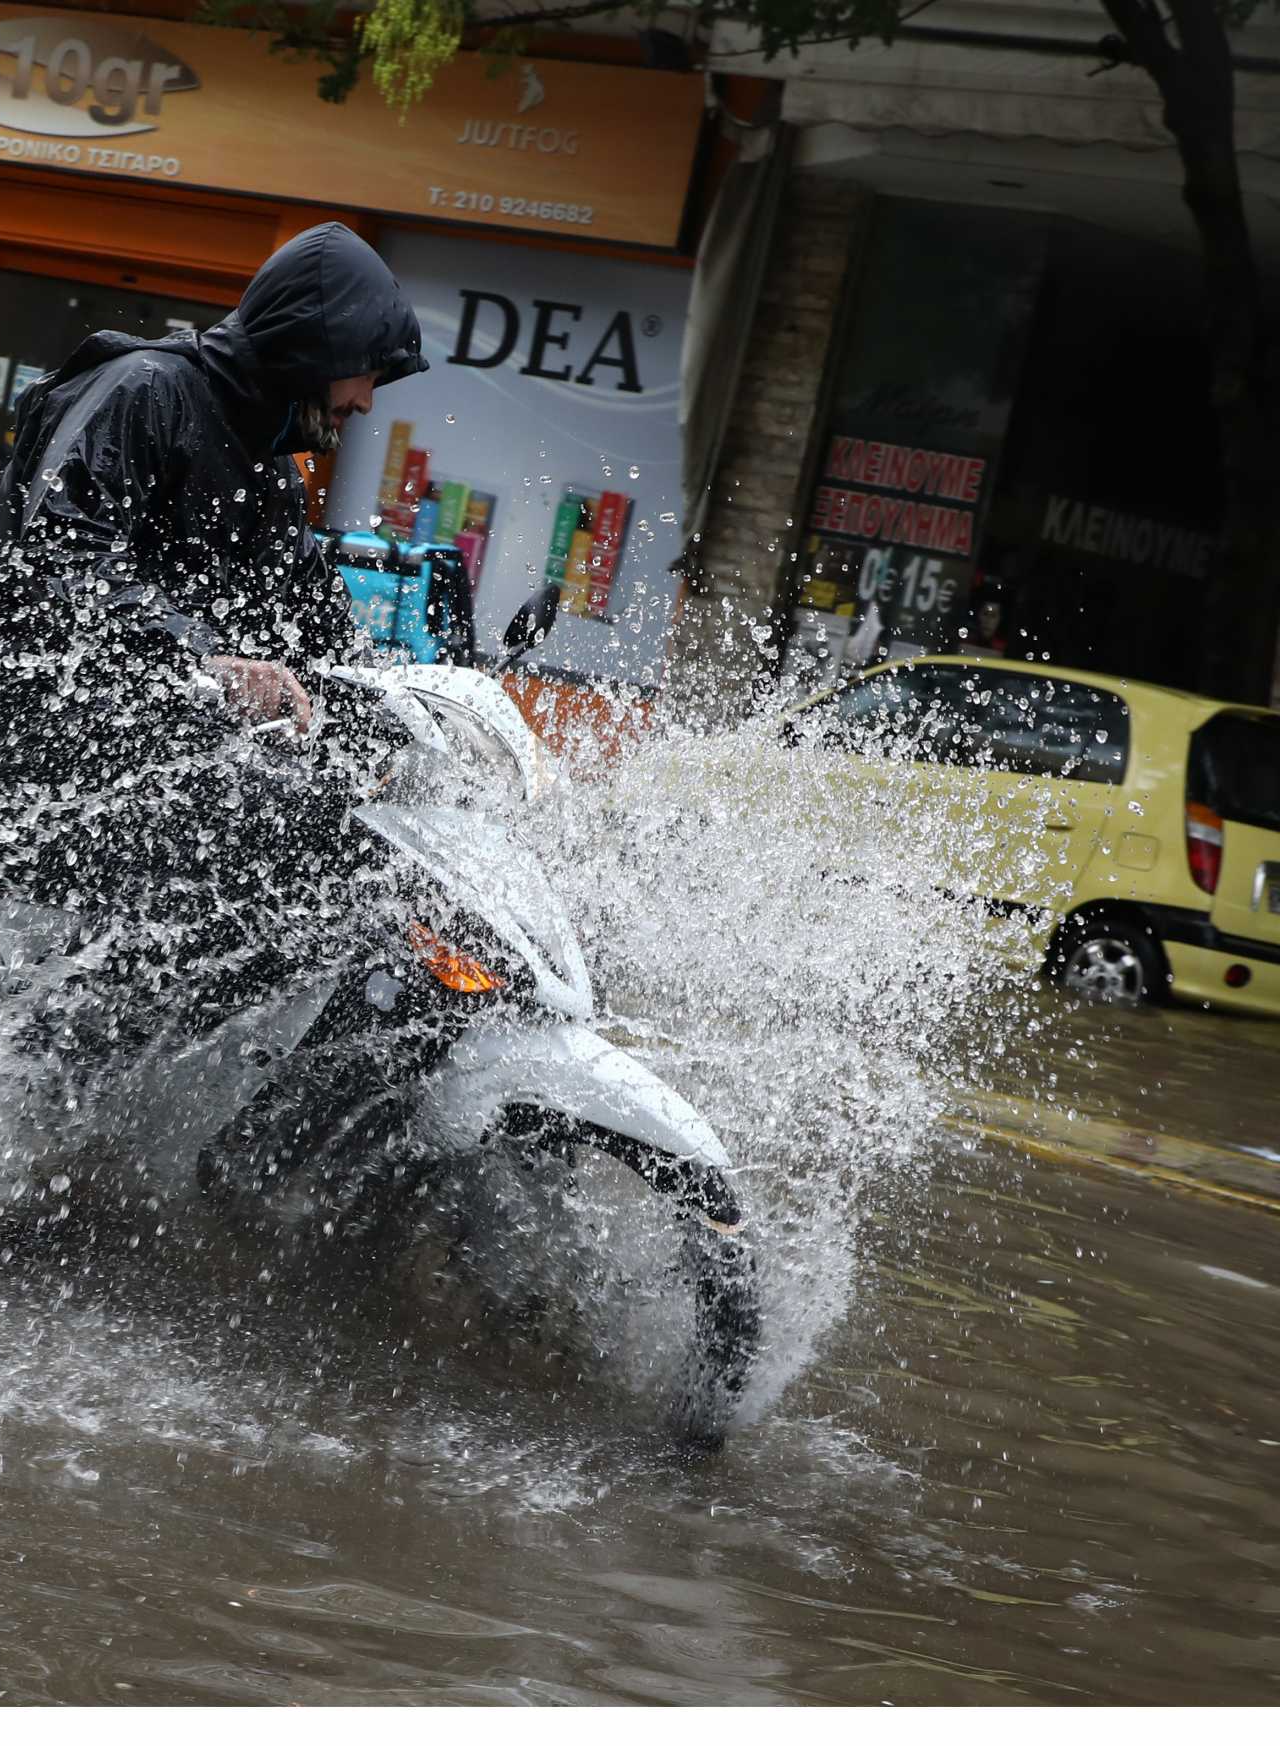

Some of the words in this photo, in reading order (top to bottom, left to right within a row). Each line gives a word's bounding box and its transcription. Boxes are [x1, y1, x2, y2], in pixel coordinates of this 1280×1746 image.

[87, 147, 181, 177] ΤΣΙΓΑΡΟ
[453, 191, 495, 213] 210
[499, 197, 593, 224] 9246682
[829, 435, 987, 503] ΚΛΕΙΝΟΥΜΕ
[811, 486, 976, 557] ΞΕΠΟΥΛΗΜΑ
